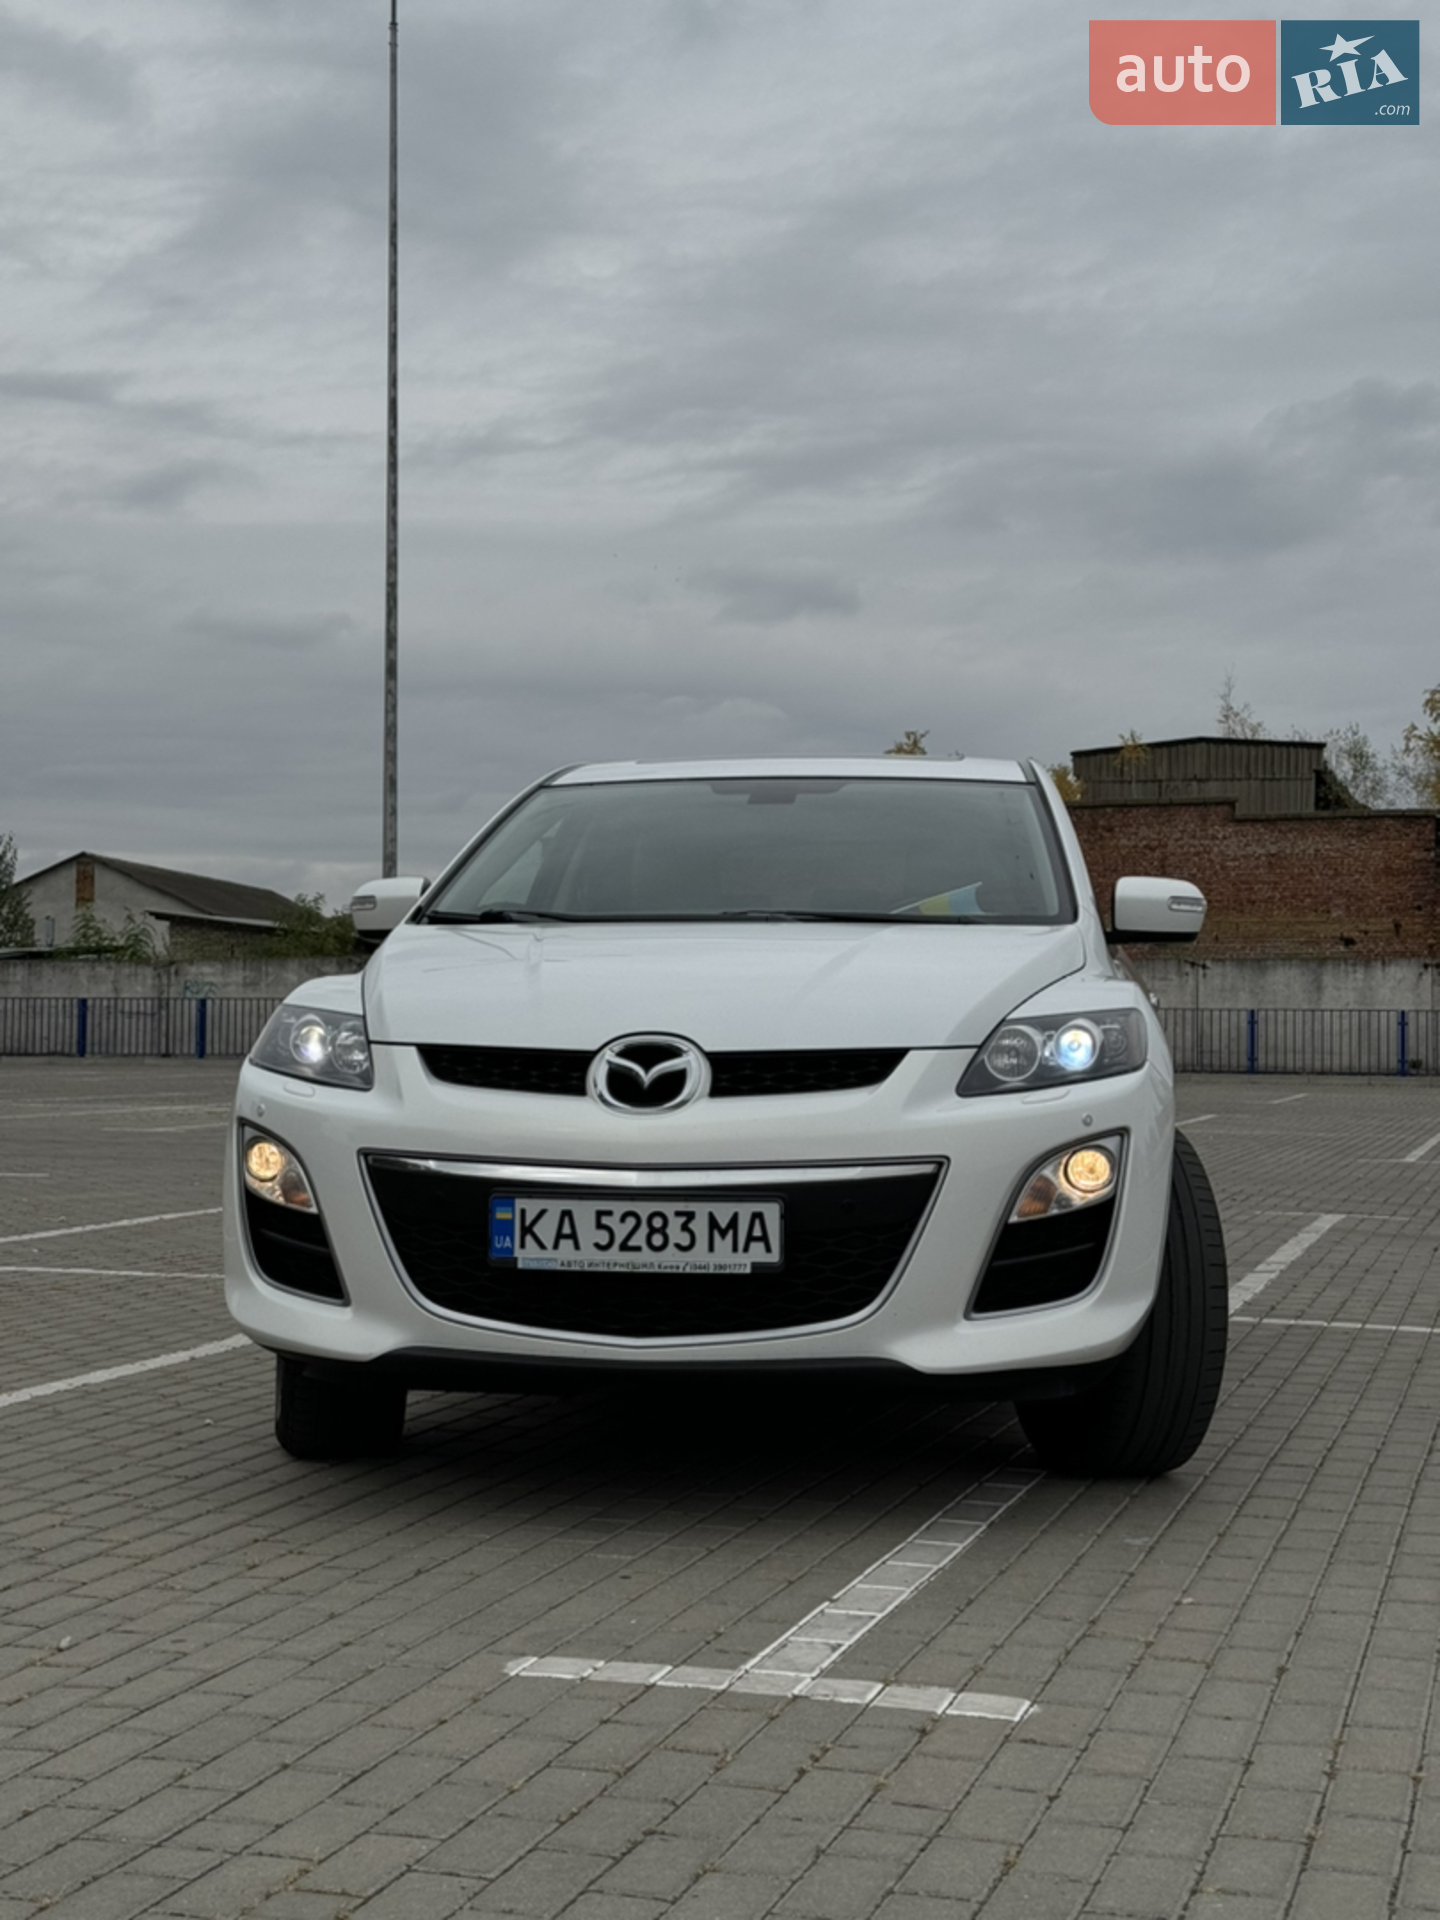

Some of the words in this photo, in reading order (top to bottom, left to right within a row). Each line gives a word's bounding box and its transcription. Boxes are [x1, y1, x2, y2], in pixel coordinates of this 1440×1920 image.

[494, 1235, 513, 1249] UA
[520, 1208, 581, 1251] KA
[592, 1209, 697, 1253] 5283
[707, 1210, 773, 1254] MA
